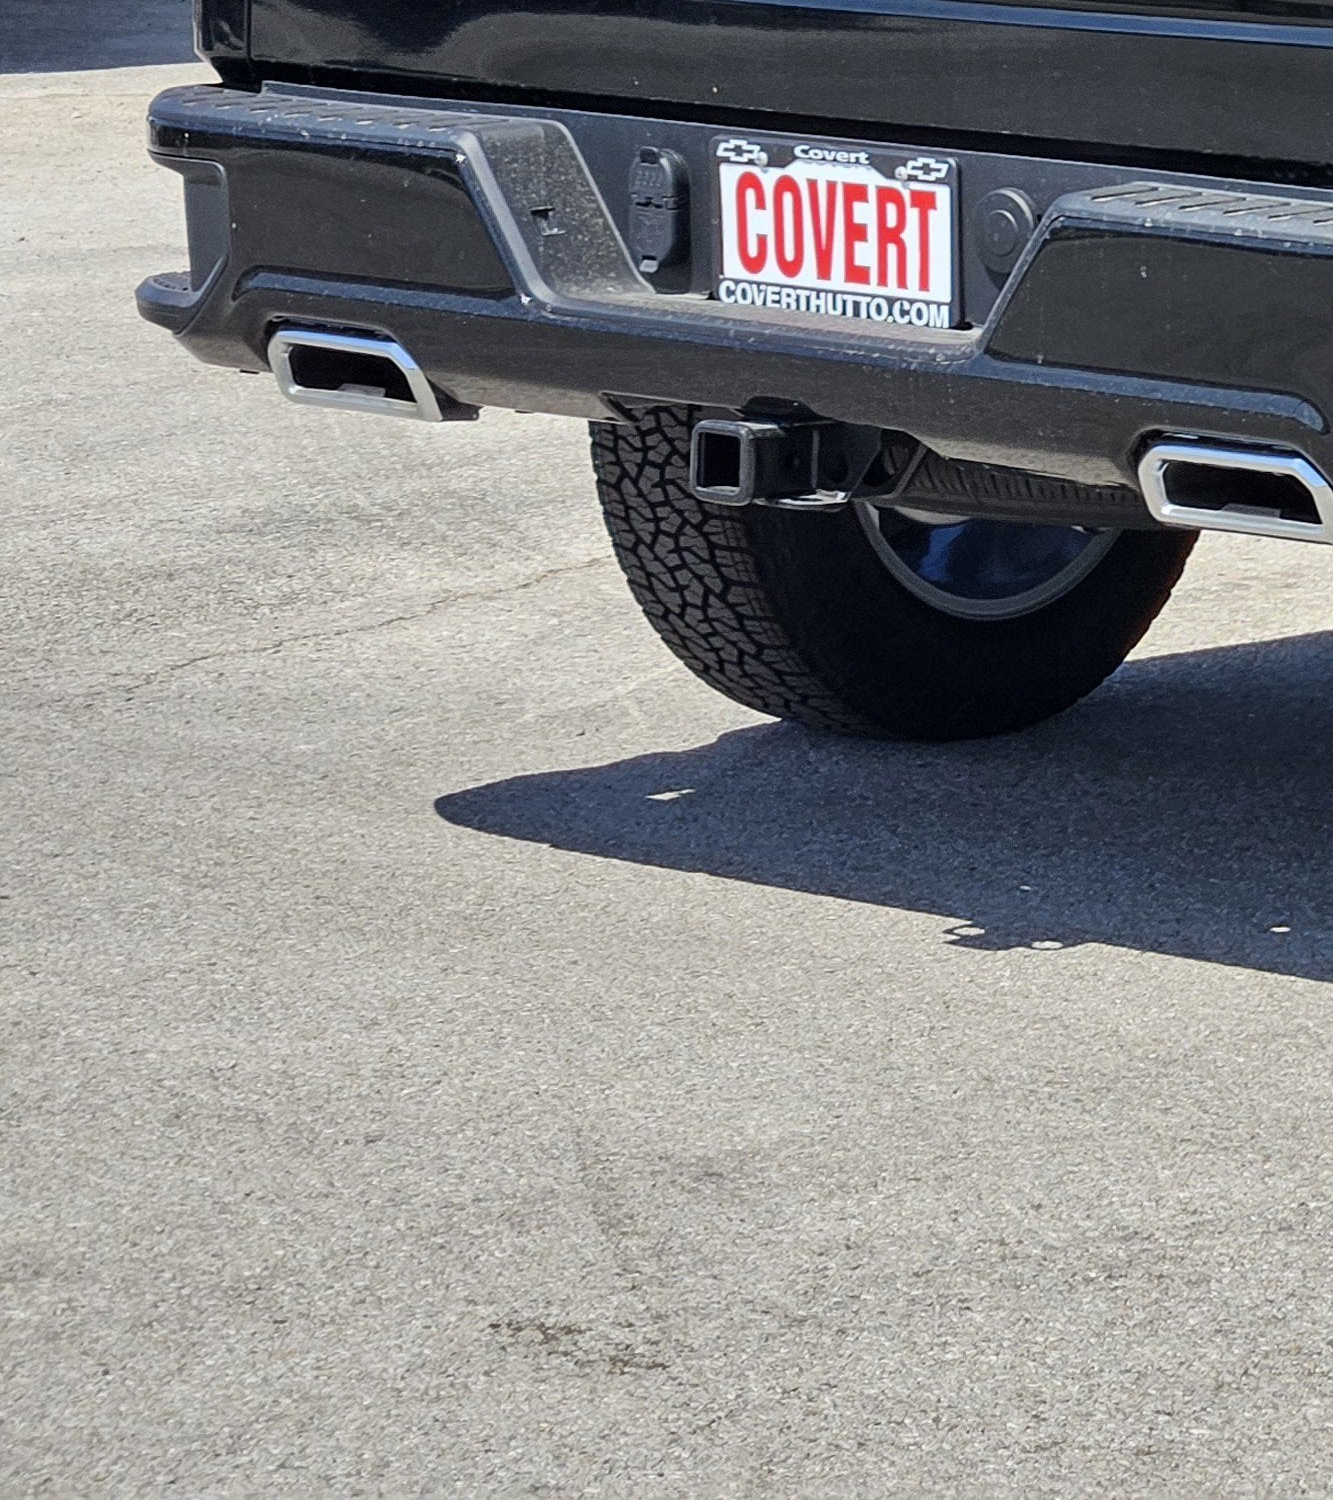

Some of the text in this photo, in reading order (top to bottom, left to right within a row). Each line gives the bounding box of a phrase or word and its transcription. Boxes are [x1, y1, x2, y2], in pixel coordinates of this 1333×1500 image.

[793, 144, 870, 165] Covert
[735, 171, 938, 293] COVERT
[718, 280, 950, 329] COVERTHUTTO.COM
